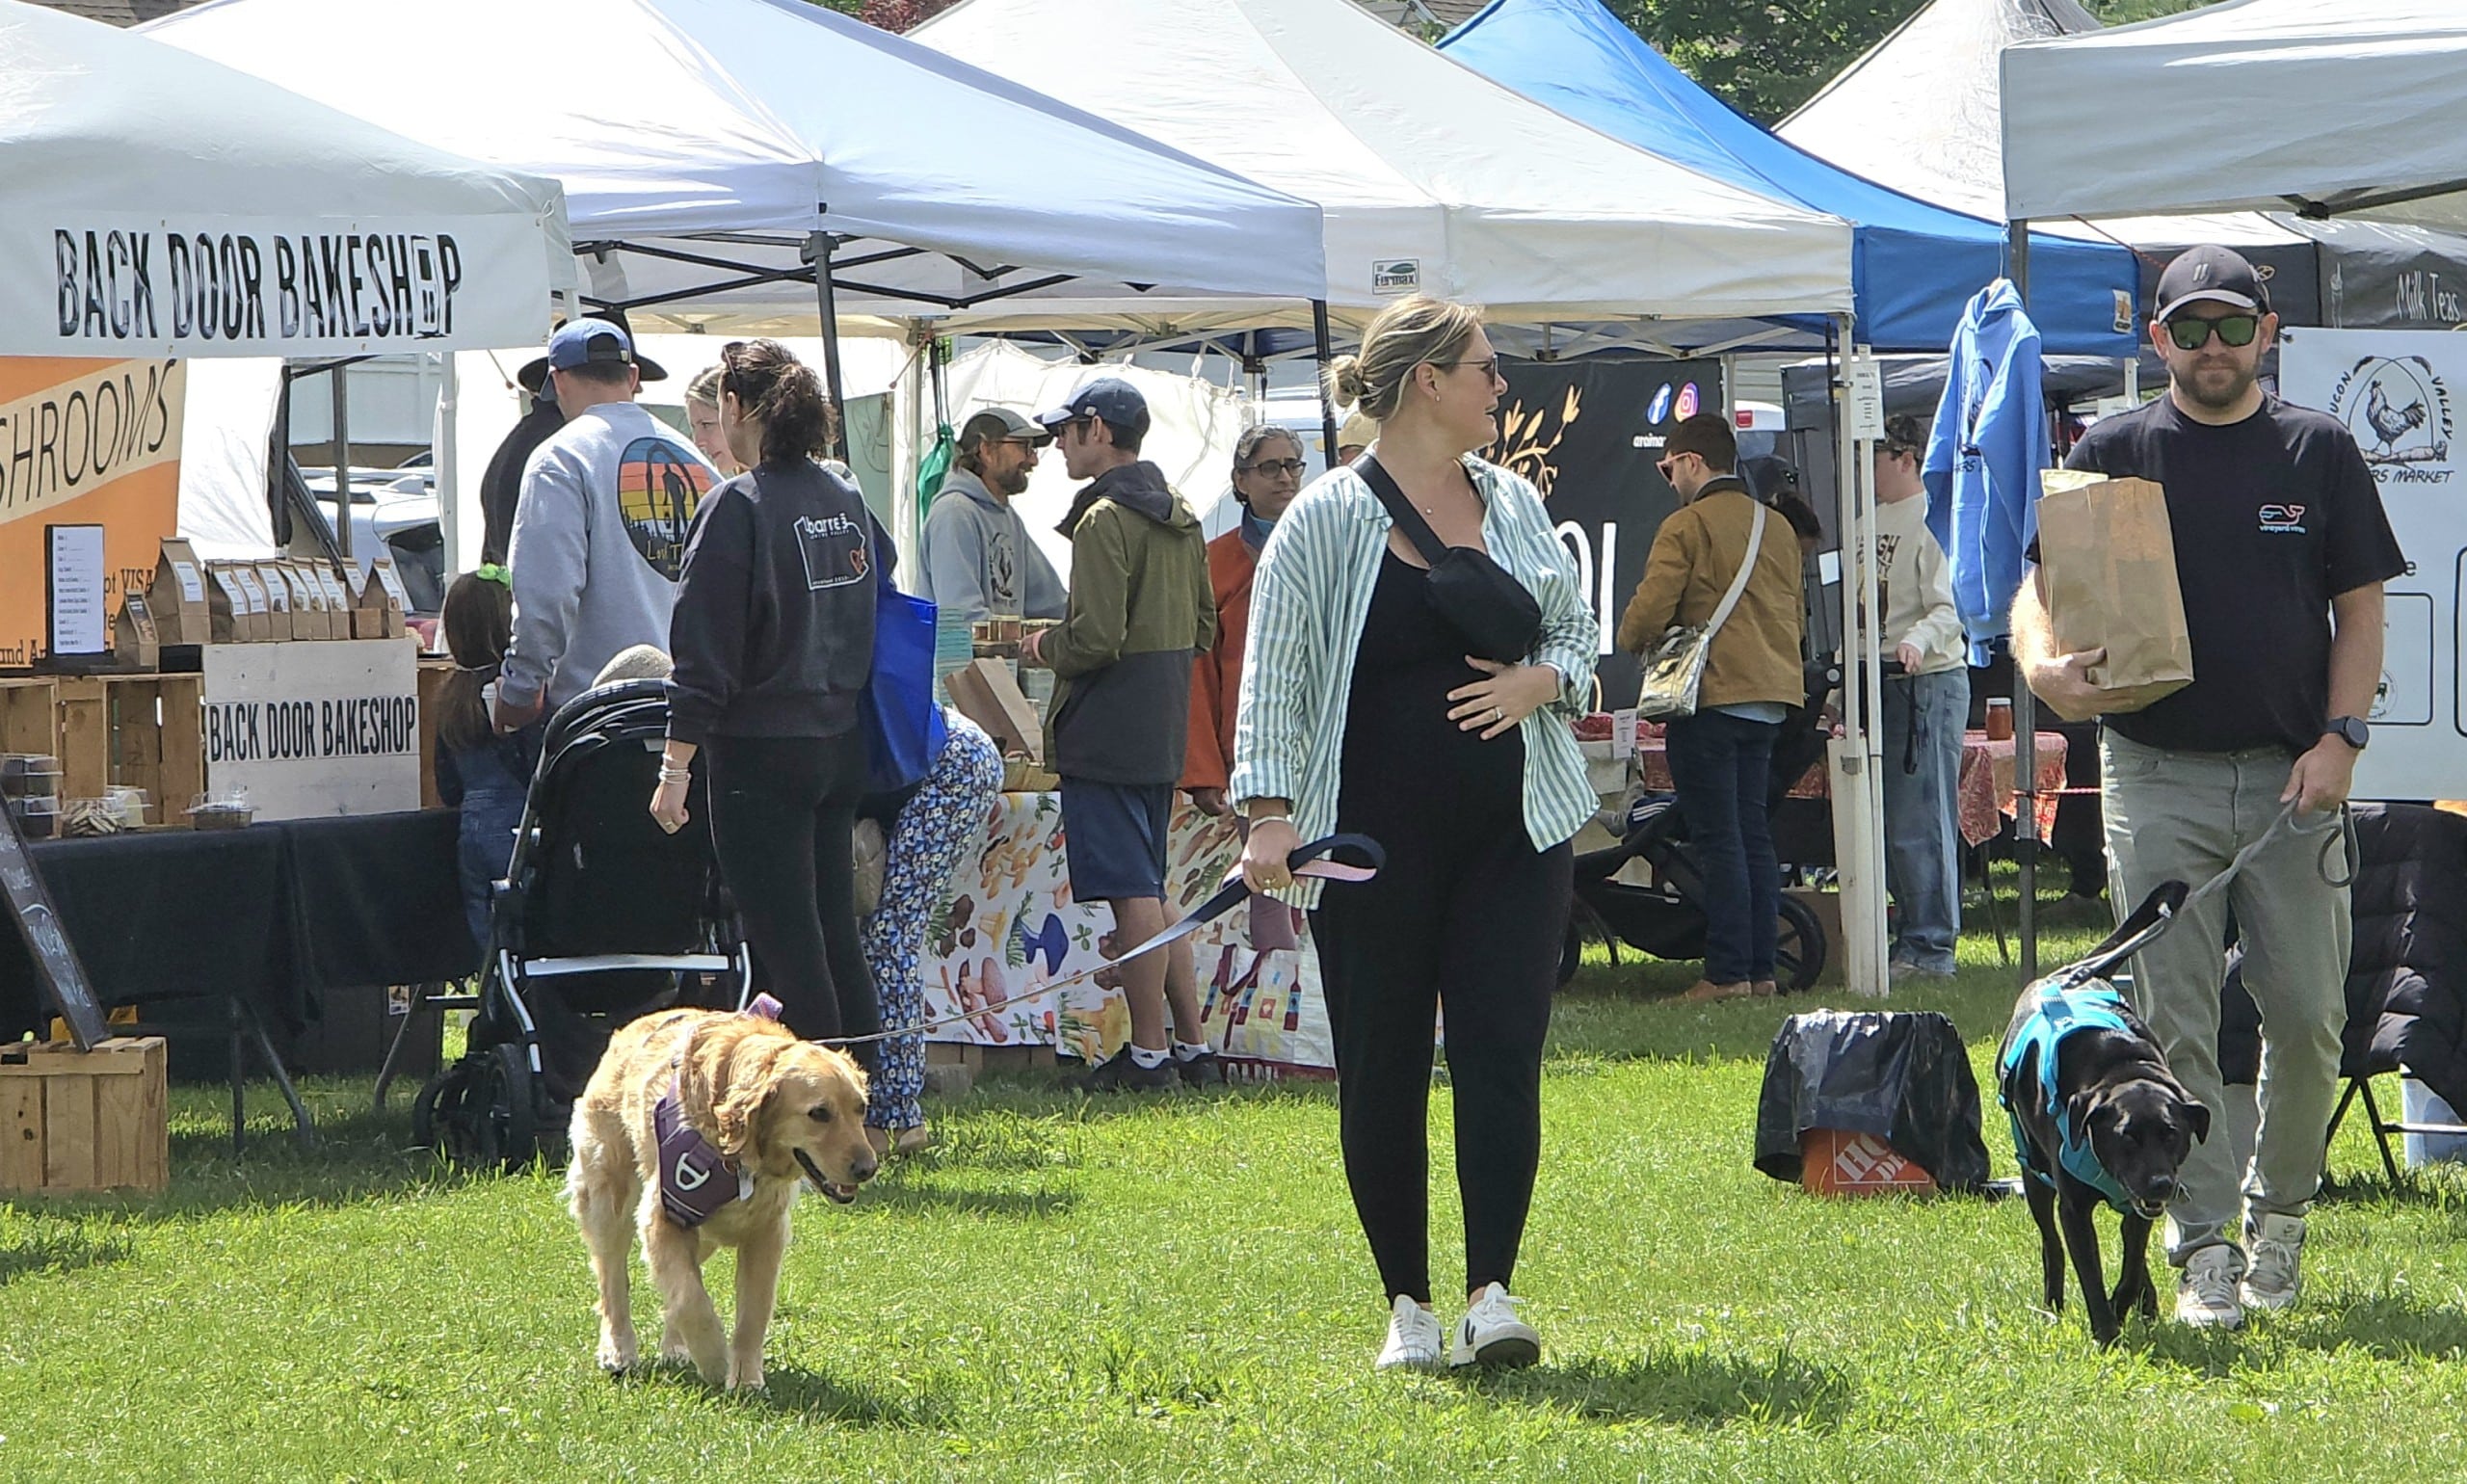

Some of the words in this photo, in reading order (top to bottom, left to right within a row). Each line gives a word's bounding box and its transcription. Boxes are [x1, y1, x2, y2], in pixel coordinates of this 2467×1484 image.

[54, 228, 159, 338] BACK
[167, 231, 266, 340] DOOR
[2396, 269, 2427, 320] Milk
[2428, 272, 2461, 323] Teas
[2328, 371, 2352, 414] UCON
[2430, 376, 2454, 440] VALLEY
[2392, 469, 2456, 484] MARKET
[209, 704, 261, 762] BACK
[267, 701, 316, 759] DOOR
[322, 696, 415, 756] BAKESHOP
